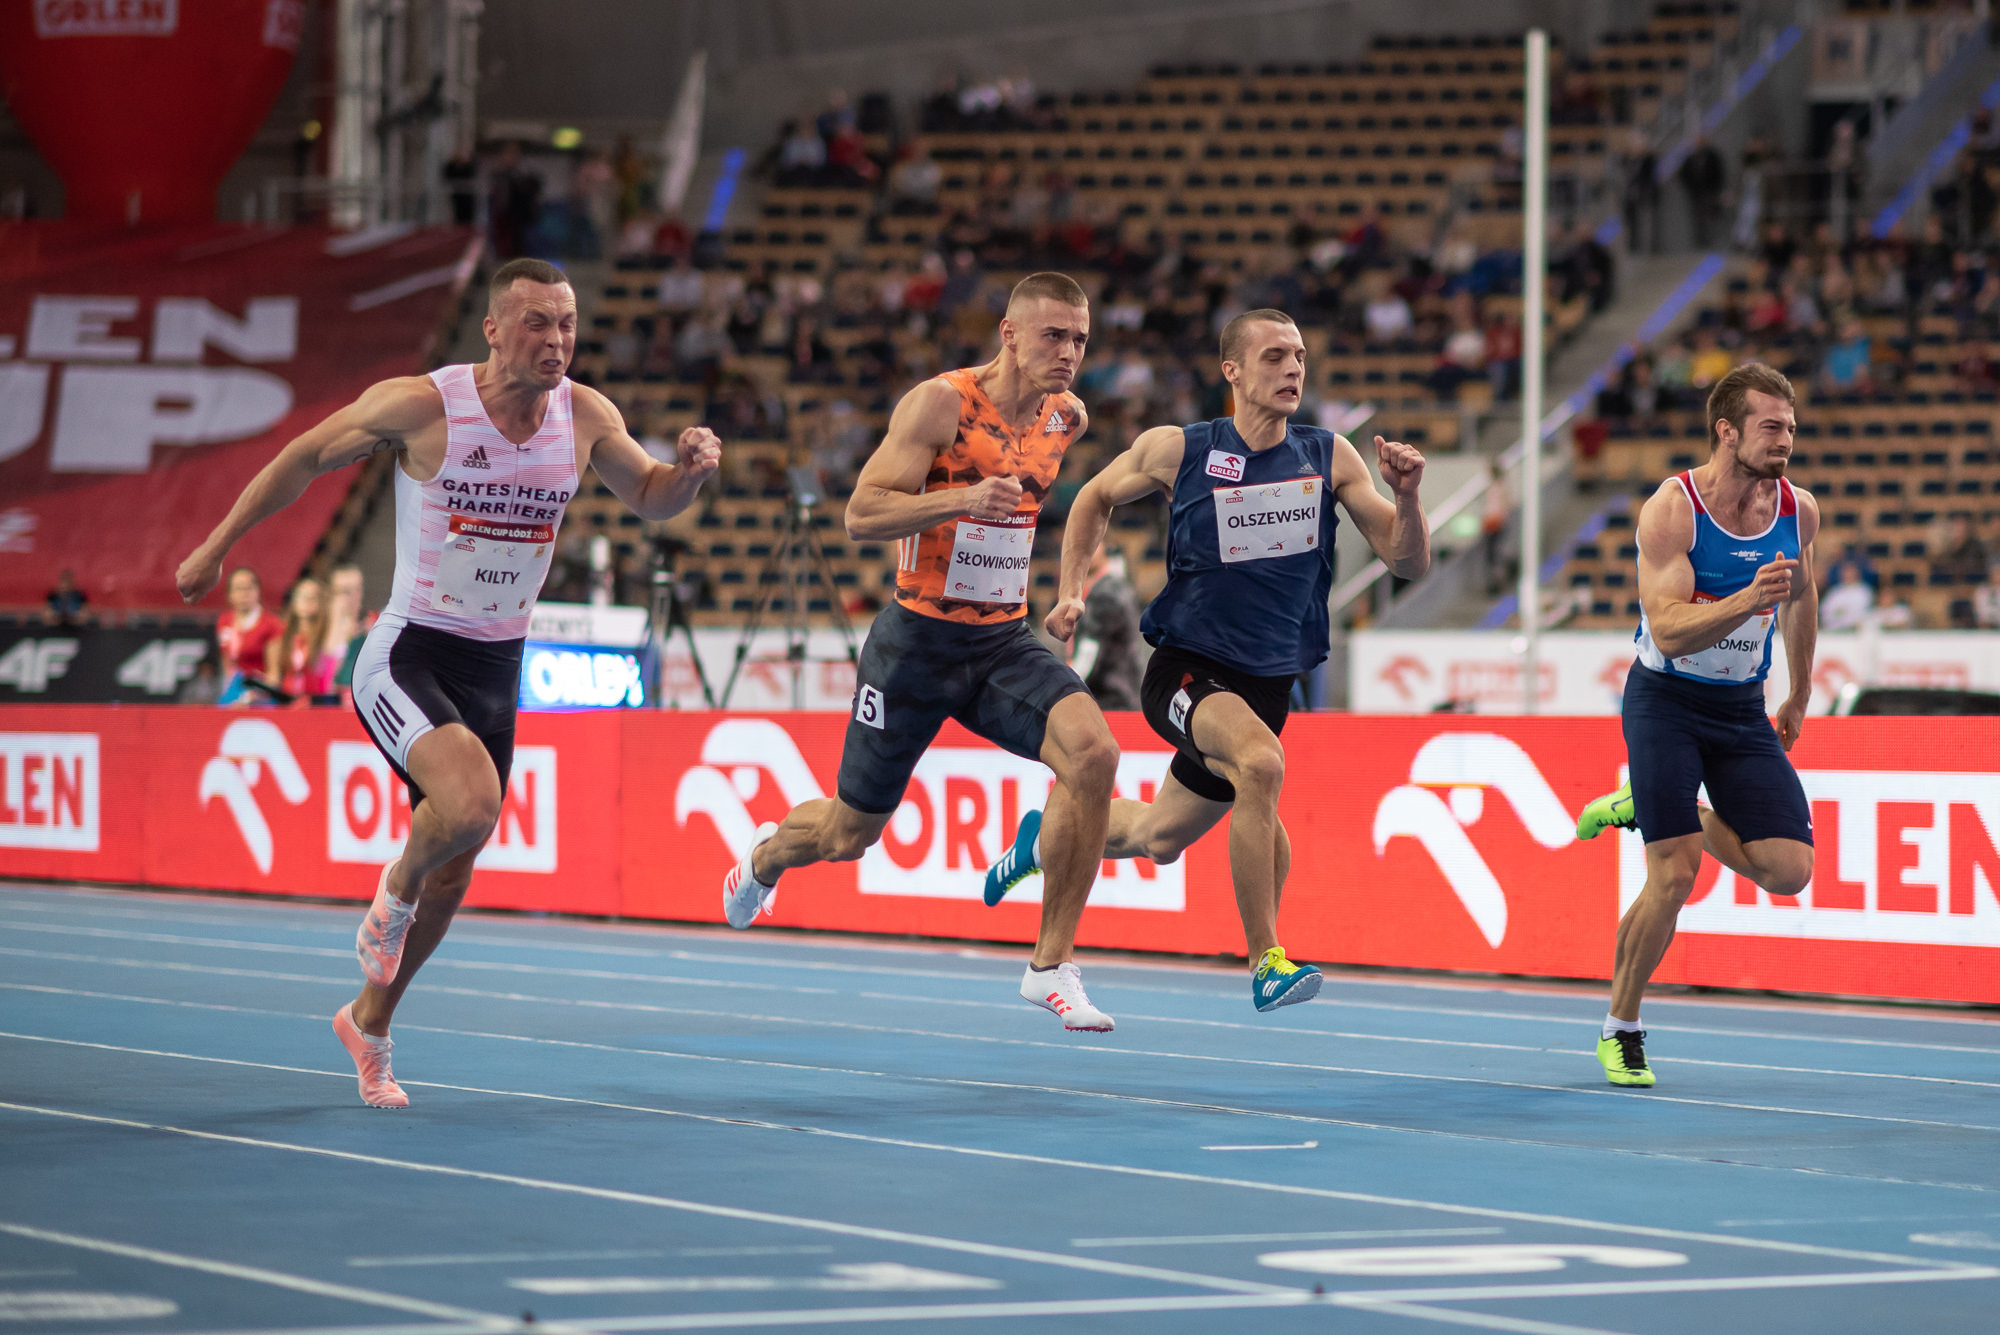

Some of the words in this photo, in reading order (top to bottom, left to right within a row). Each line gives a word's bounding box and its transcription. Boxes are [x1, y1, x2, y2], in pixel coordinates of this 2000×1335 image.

[0, 294, 299, 362] EN
[1045, 424, 1067, 432] adidas
[462, 460, 491, 470] adidas
[1211, 466, 1239, 478] ORLEN
[1227, 506, 1316, 529] OLSZEWSKI
[460, 522, 491, 536] ORLEN
[491, 528, 508, 537] CUP
[508, 525, 532, 539] ŁÓDŹ
[474, 568, 521, 585] KILTY
[115, 638, 208, 695] 4F
[862, 688, 877, 722] 5
[1172, 698, 1186, 725] 4
